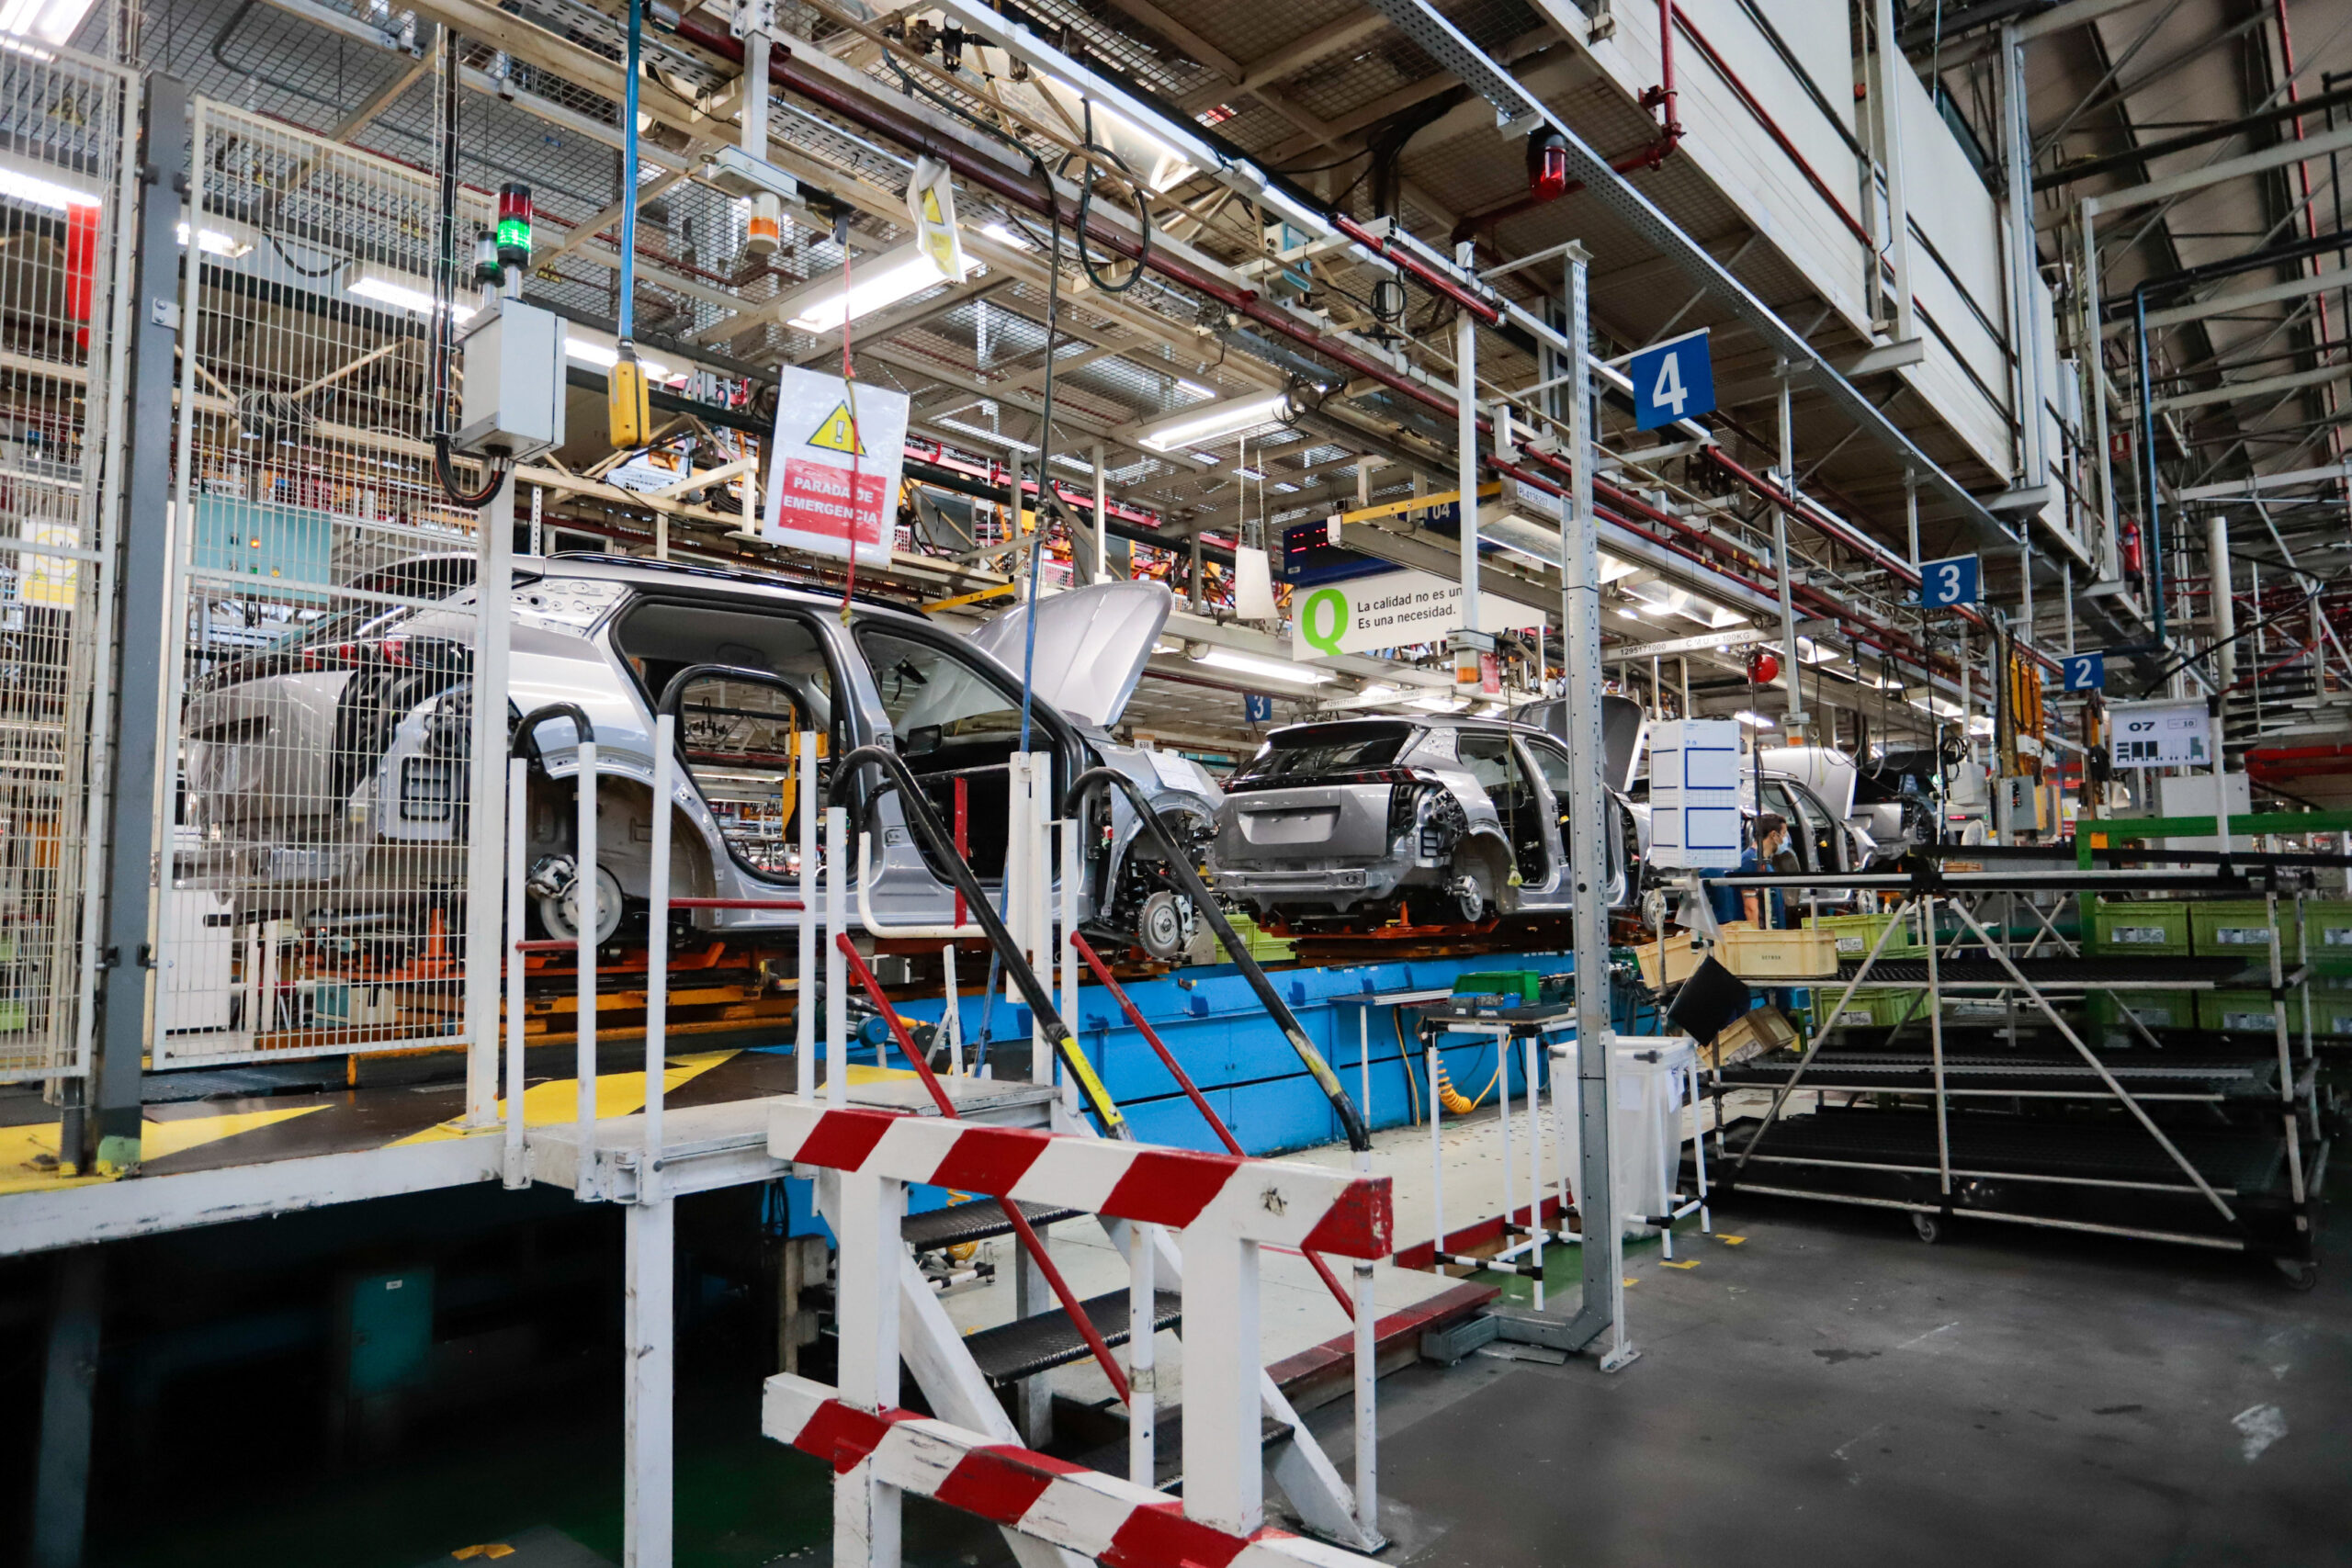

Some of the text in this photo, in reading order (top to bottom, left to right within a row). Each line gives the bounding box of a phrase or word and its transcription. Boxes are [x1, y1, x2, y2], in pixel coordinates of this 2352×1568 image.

[1652, 351, 1689, 416] 4
[793, 476, 875, 503] PARADA DE
[783, 494, 878, 524] EMERGENCIA
[1432, 502, 1451, 520] 04
[1937, 564, 1962, 604] 3
[1357, 602, 1371, 613] La
[1374, 592, 1412, 611] calidad
[1415, 592, 1430, 603] no
[1432, 591, 1445, 600] es
[1302, 589, 1349, 656] Q
[1358, 604, 1456, 629] Es una necesidad.
[1620, 643, 1667, 656] 1295171000
[1722, 631, 1751, 642] 100KG
[2075, 658, 2095, 688] 2
[1253, 694, 1264, 719] 3
[2128, 721, 2155, 732] 07
